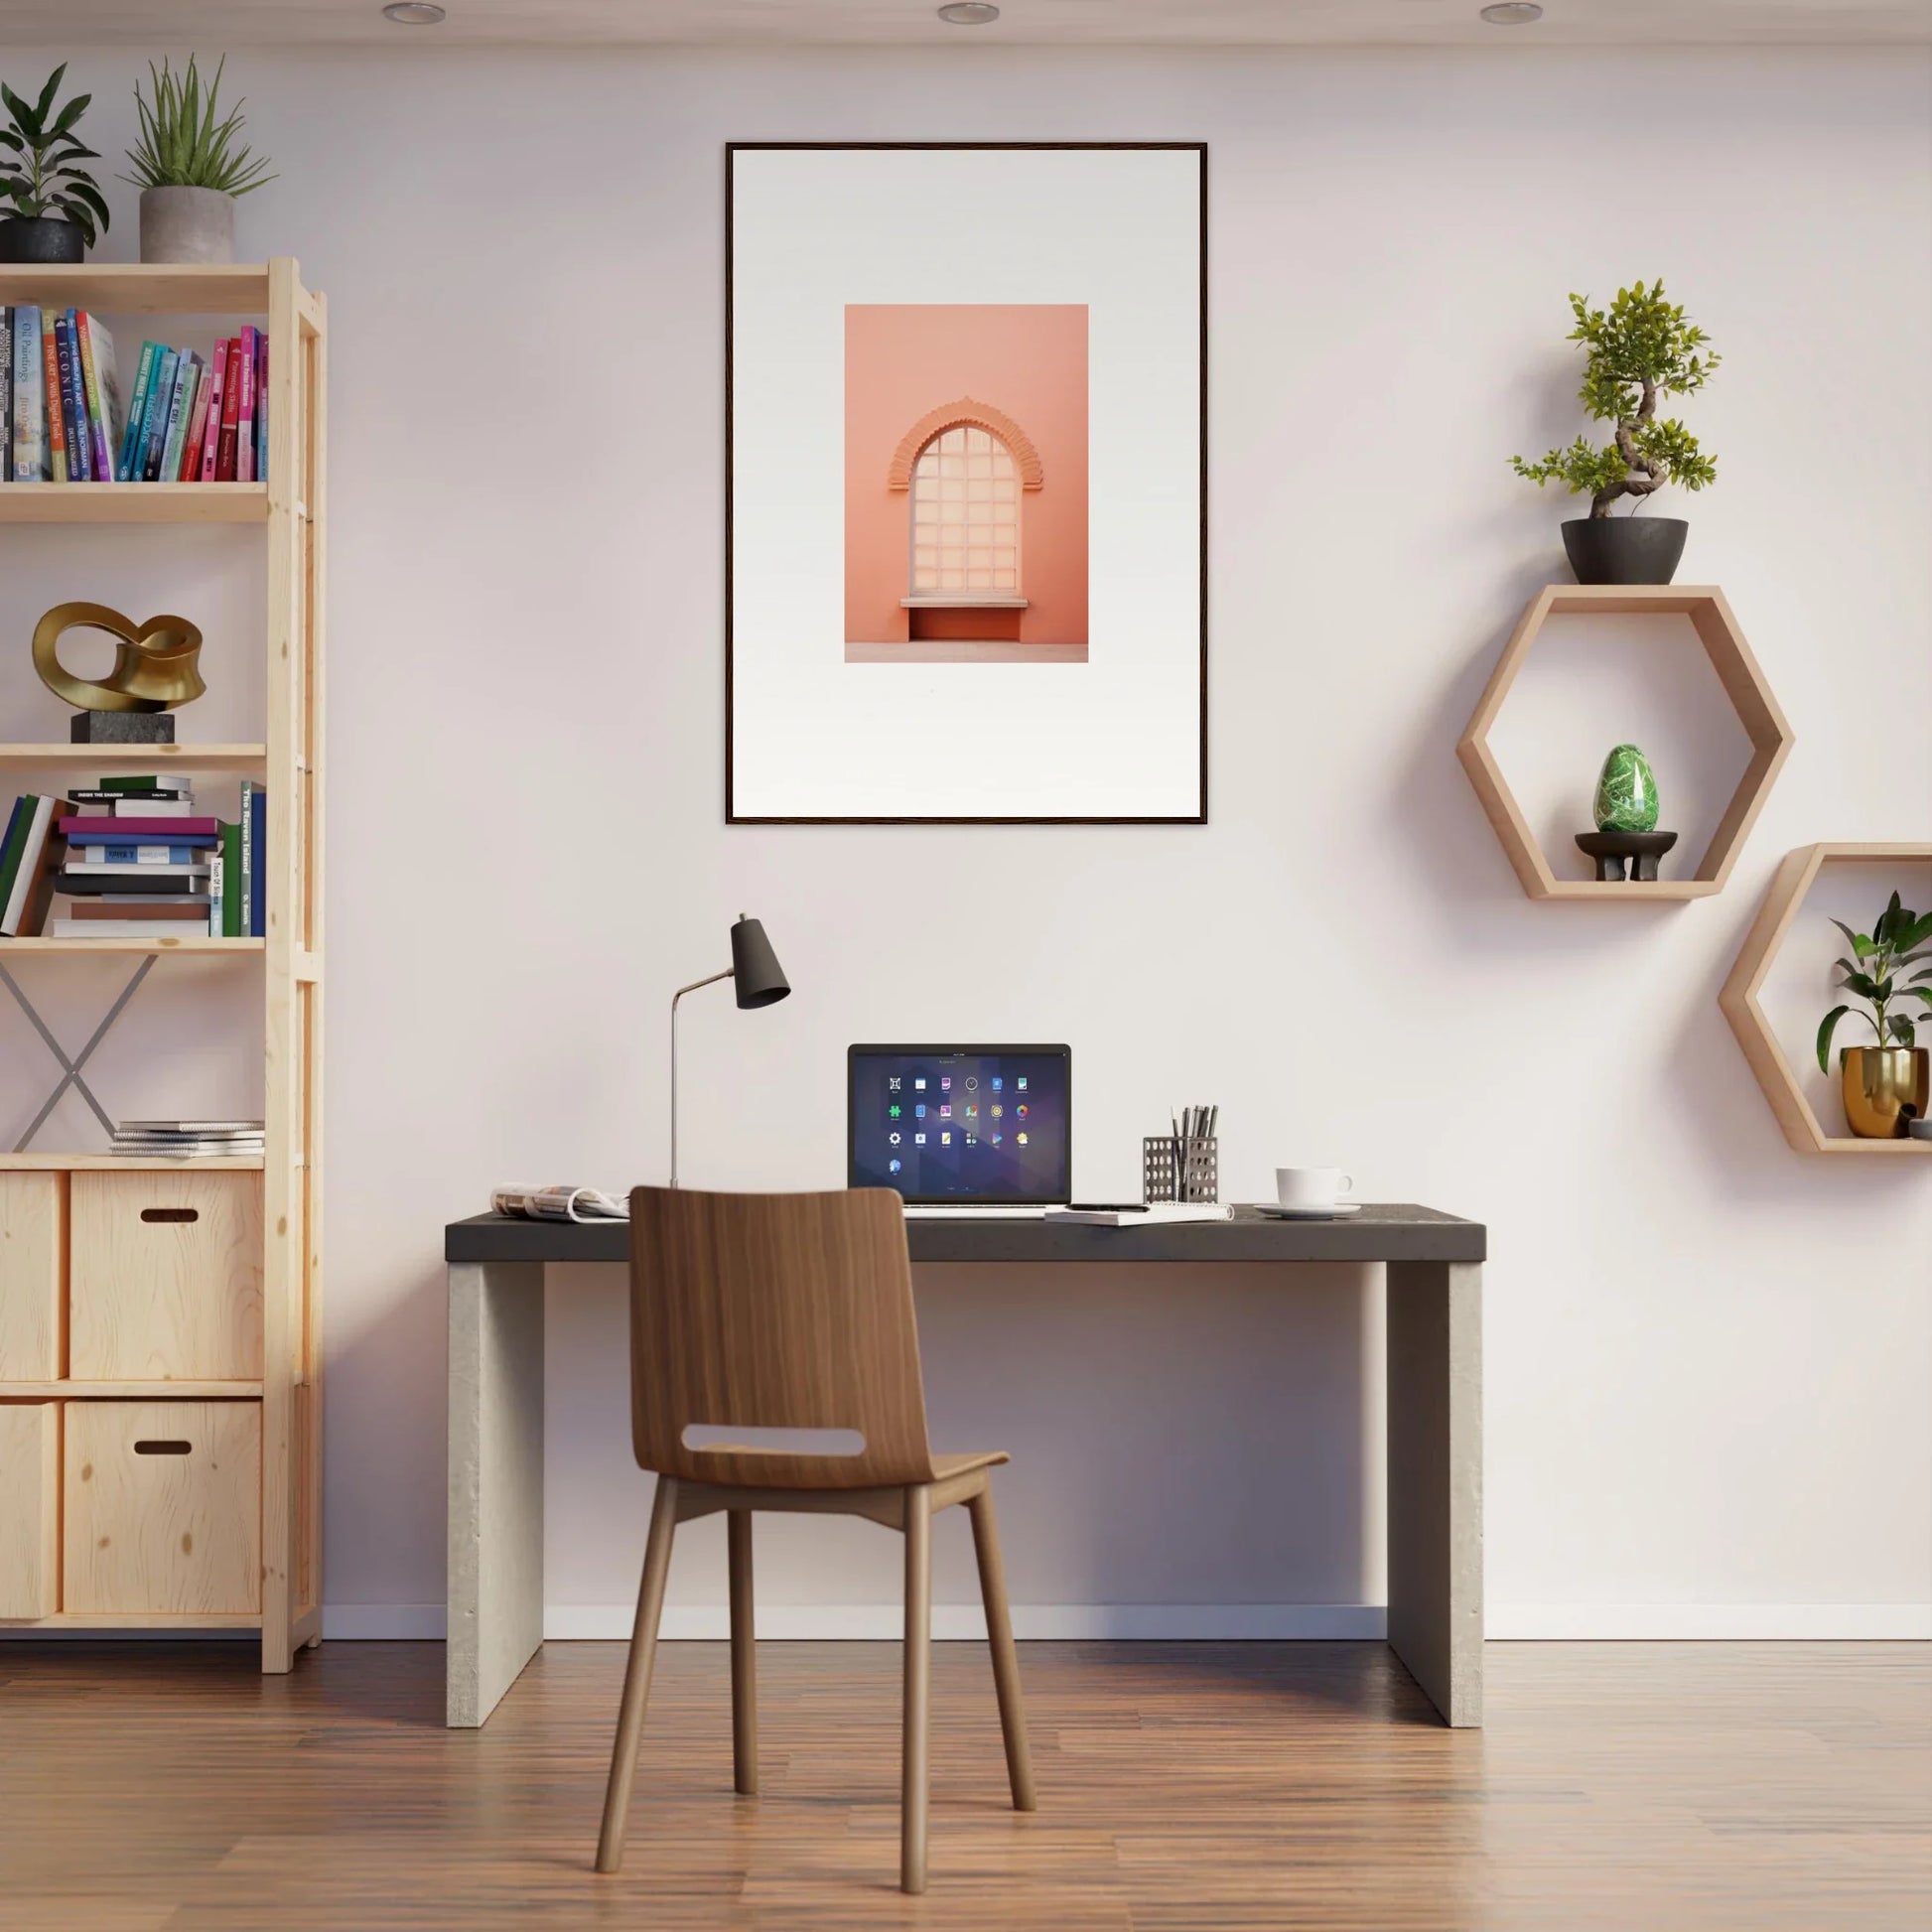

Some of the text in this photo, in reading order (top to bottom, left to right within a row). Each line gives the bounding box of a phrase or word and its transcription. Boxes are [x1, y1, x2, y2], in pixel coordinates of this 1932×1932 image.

[19, 323, 32, 382] Oil Paintings
[59, 342, 72, 405] ICONIC
[79, 325, 98, 408] Watercolor Portraits
[228, 360, 239, 394] Parenting
[50, 399, 60, 422] Digital
